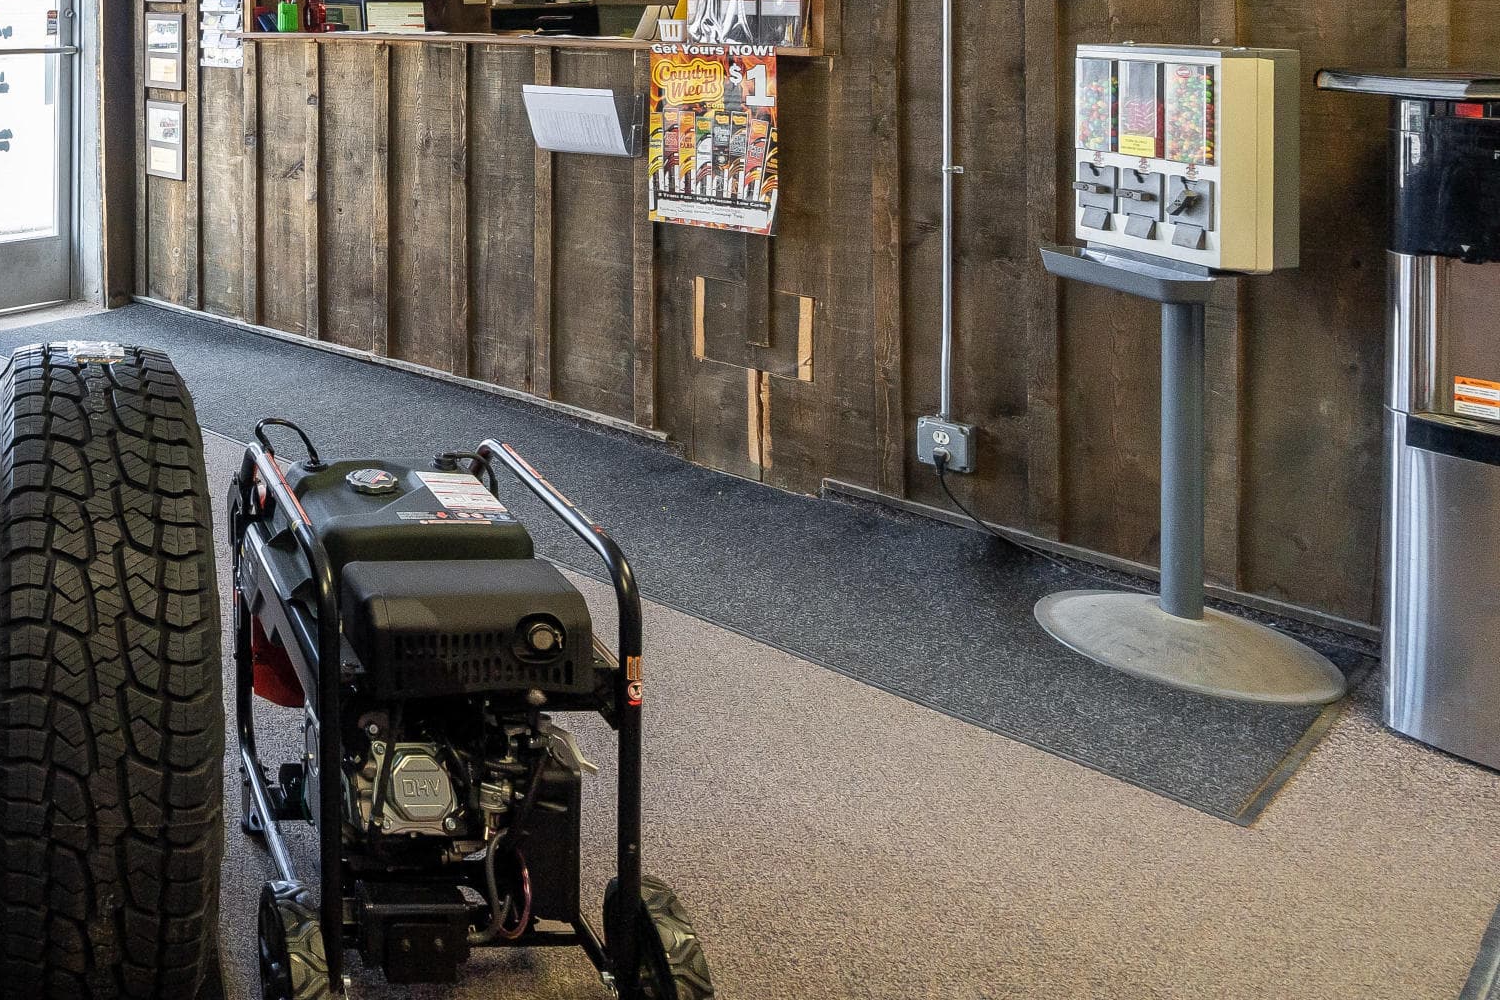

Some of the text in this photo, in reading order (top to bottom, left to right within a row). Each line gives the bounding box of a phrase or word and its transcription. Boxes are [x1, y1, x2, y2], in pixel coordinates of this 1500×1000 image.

[651, 43, 776, 56] Get Yours NOW!
[659, 63, 718, 81] Country
[671, 80, 718, 98] Meats
[402, 778, 441, 797] OHV
